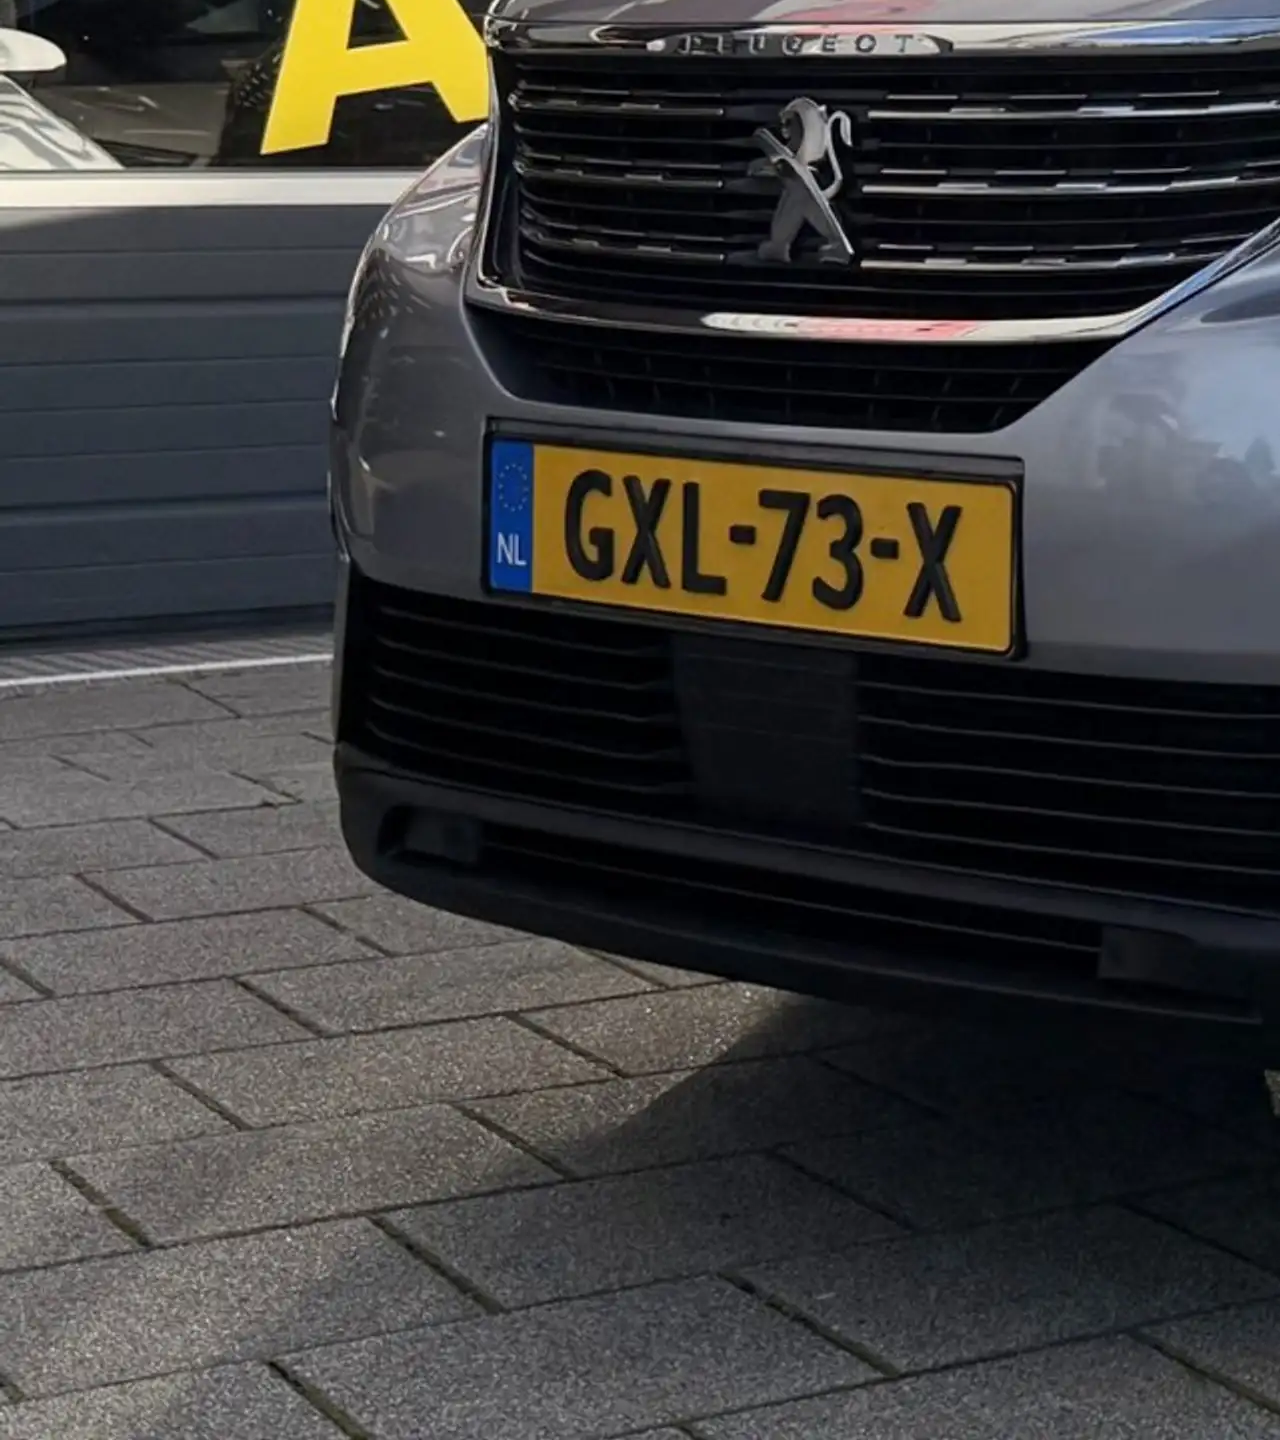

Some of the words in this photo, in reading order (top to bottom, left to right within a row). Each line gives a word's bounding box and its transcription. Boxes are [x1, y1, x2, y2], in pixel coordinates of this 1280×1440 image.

[680, 32, 916, 55] PEUGEOT
[497, 532, 528, 566] NL
[564, 468, 964, 624] GXL-73-X
